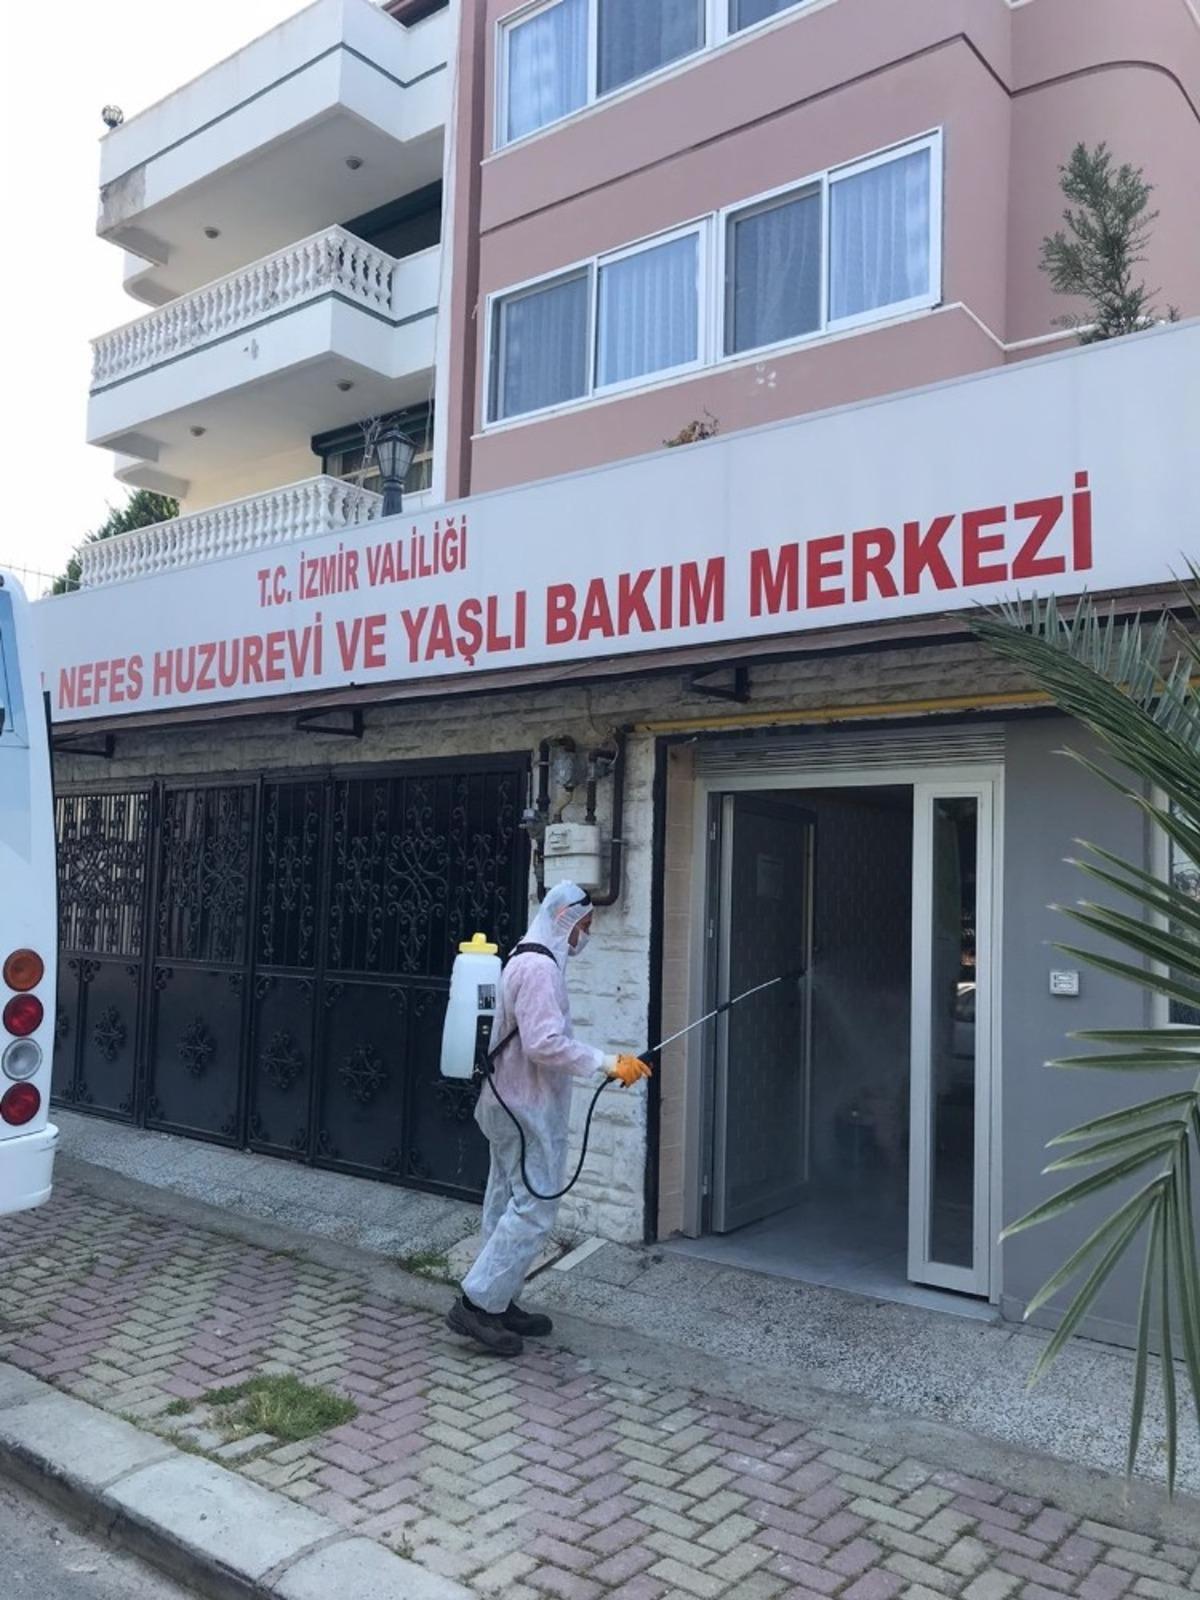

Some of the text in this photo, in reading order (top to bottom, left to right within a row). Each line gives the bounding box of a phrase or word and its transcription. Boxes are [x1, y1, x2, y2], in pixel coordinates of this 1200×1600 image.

[58, 472, 1092, 710] NEFES HUZUREVİ VE YAŞLI BAKIM MERKEZİ
[257, 514, 468, 607] T.C. İZMİR VALİLİĞİ
